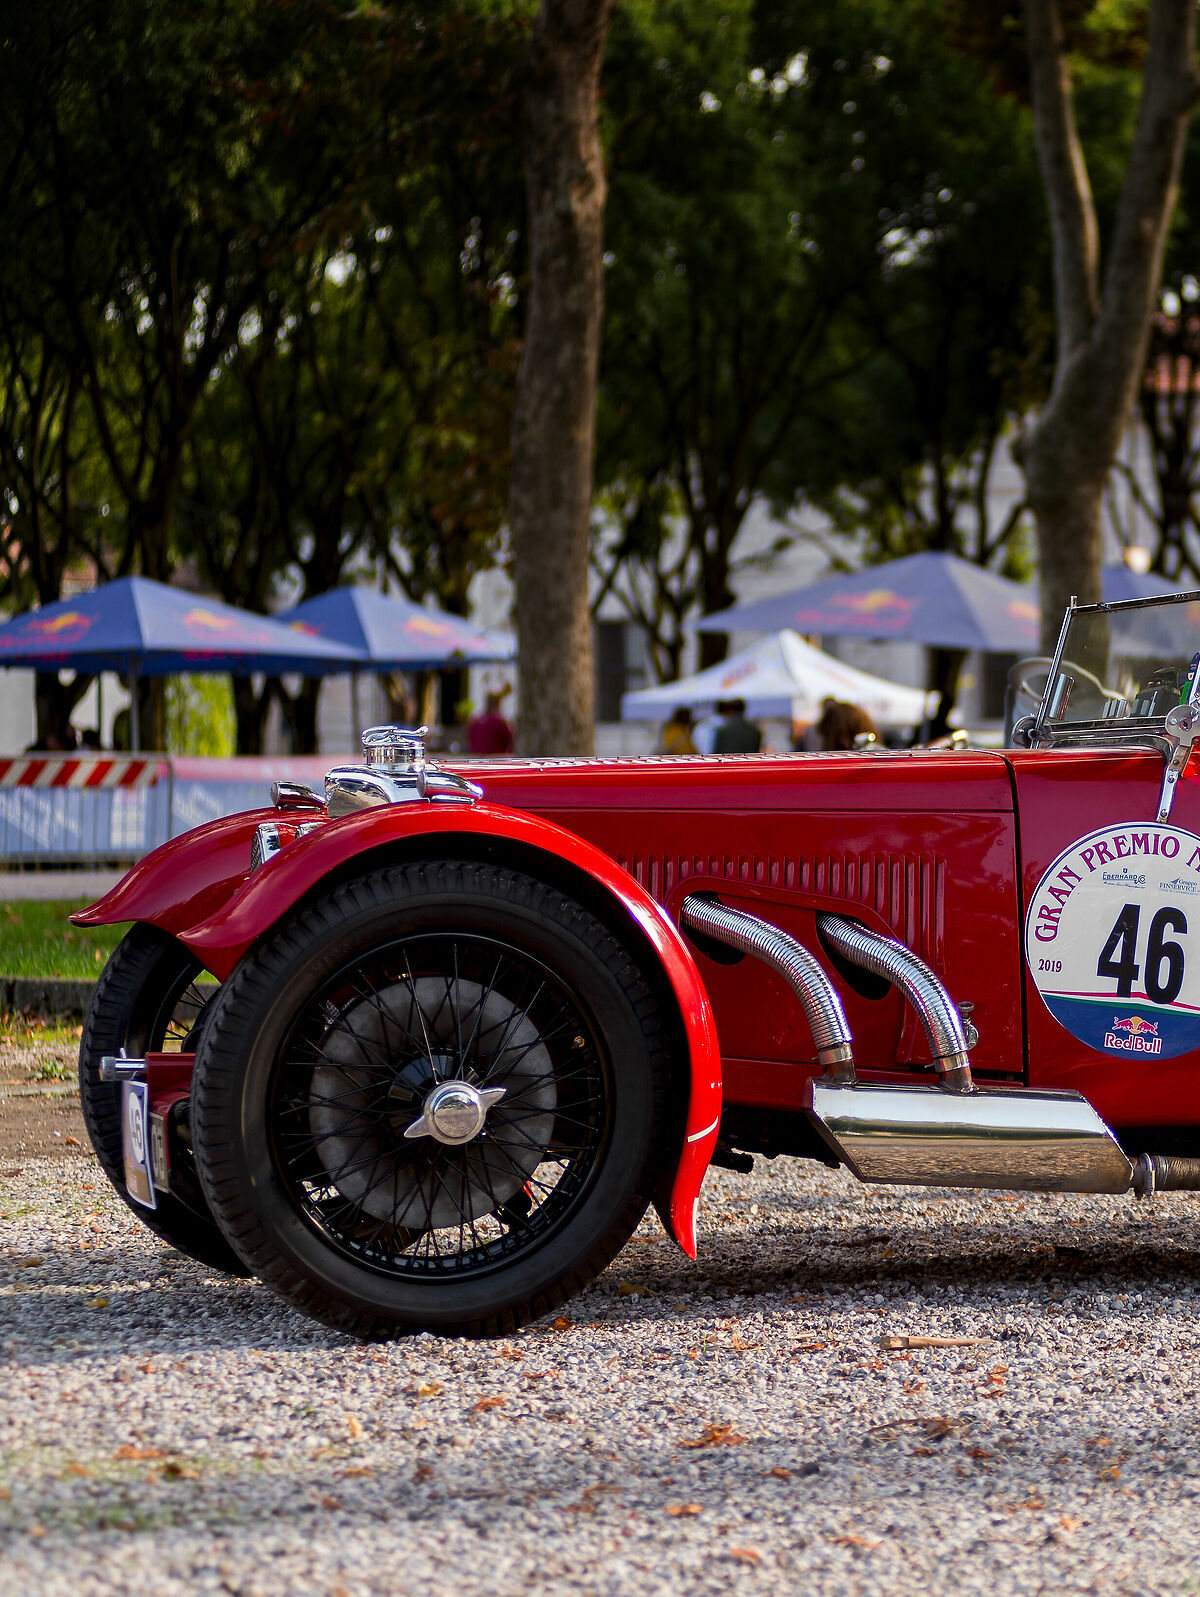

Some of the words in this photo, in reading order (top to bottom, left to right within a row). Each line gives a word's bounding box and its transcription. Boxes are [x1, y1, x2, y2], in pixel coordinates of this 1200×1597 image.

[1034, 865, 1083, 943] GRAN
[1079, 832, 1180, 873] PREMIO
[1038, 958, 1062, 973] 2019
[1096, 903, 1188, 1005] 46
[1105, 1033, 1134, 1051] Red
[1134, 1035, 1162, 1054] Bull
